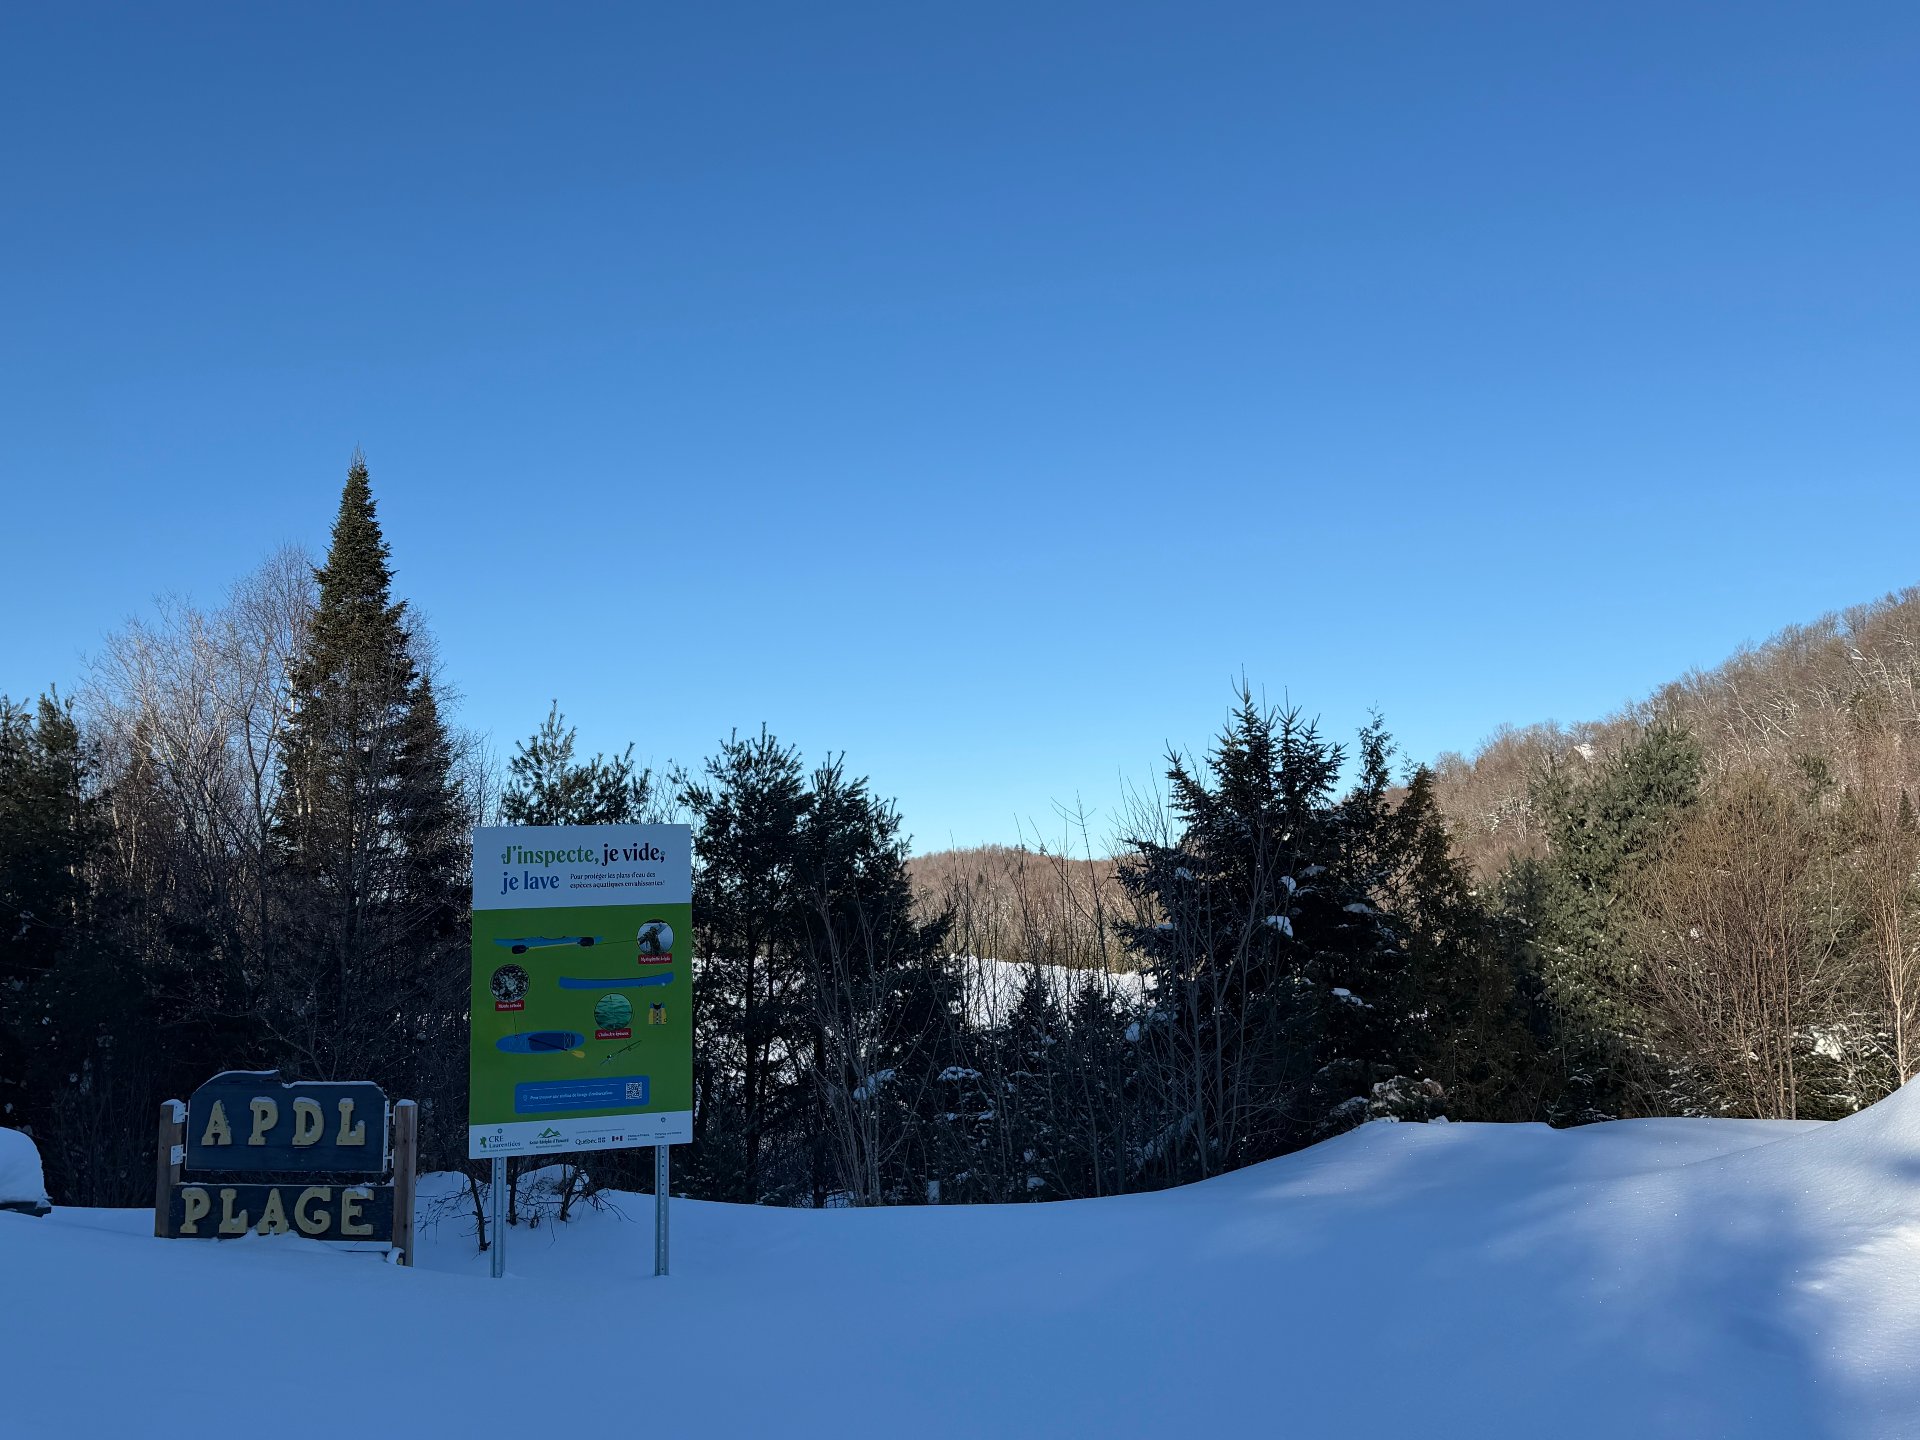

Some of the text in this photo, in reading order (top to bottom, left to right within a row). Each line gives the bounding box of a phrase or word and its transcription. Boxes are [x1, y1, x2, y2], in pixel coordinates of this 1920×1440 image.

[502, 843, 665, 867] J'inspecte, je vide,
[501, 871, 560, 895] je lave
[569, 882, 592, 890] espèces
[592, 881, 624, 889] aquatiques
[584, 872, 607, 881] protéger
[616, 872, 631, 880] plans
[201, 1098, 365, 1146] APDL
[488, 1135, 504, 1143] CRE
[179, 1186, 375, 1236] PLAGE
